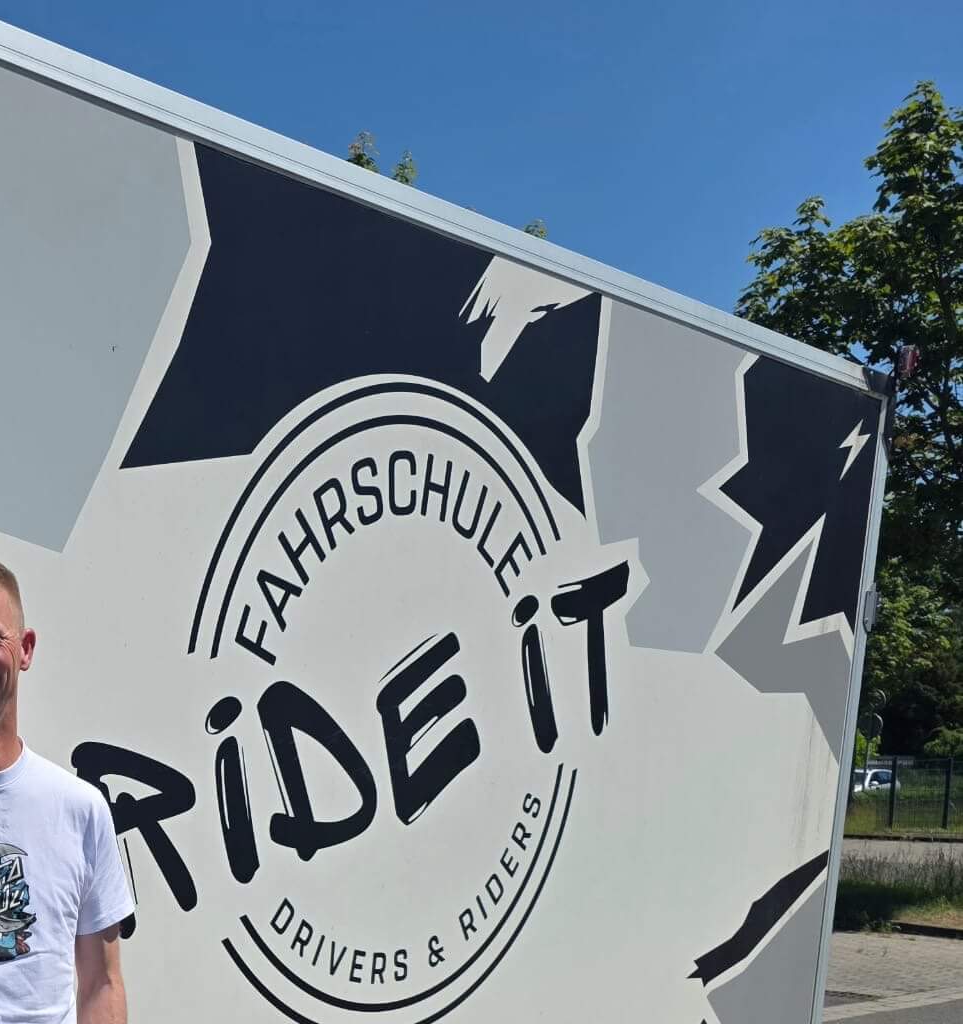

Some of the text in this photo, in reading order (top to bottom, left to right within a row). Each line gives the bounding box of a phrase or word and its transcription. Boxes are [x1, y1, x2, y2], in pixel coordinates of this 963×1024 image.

[235, 450, 533, 665] FAHRSCHULE
[269, 792, 543, 985] DRIVERS & RIDERS
